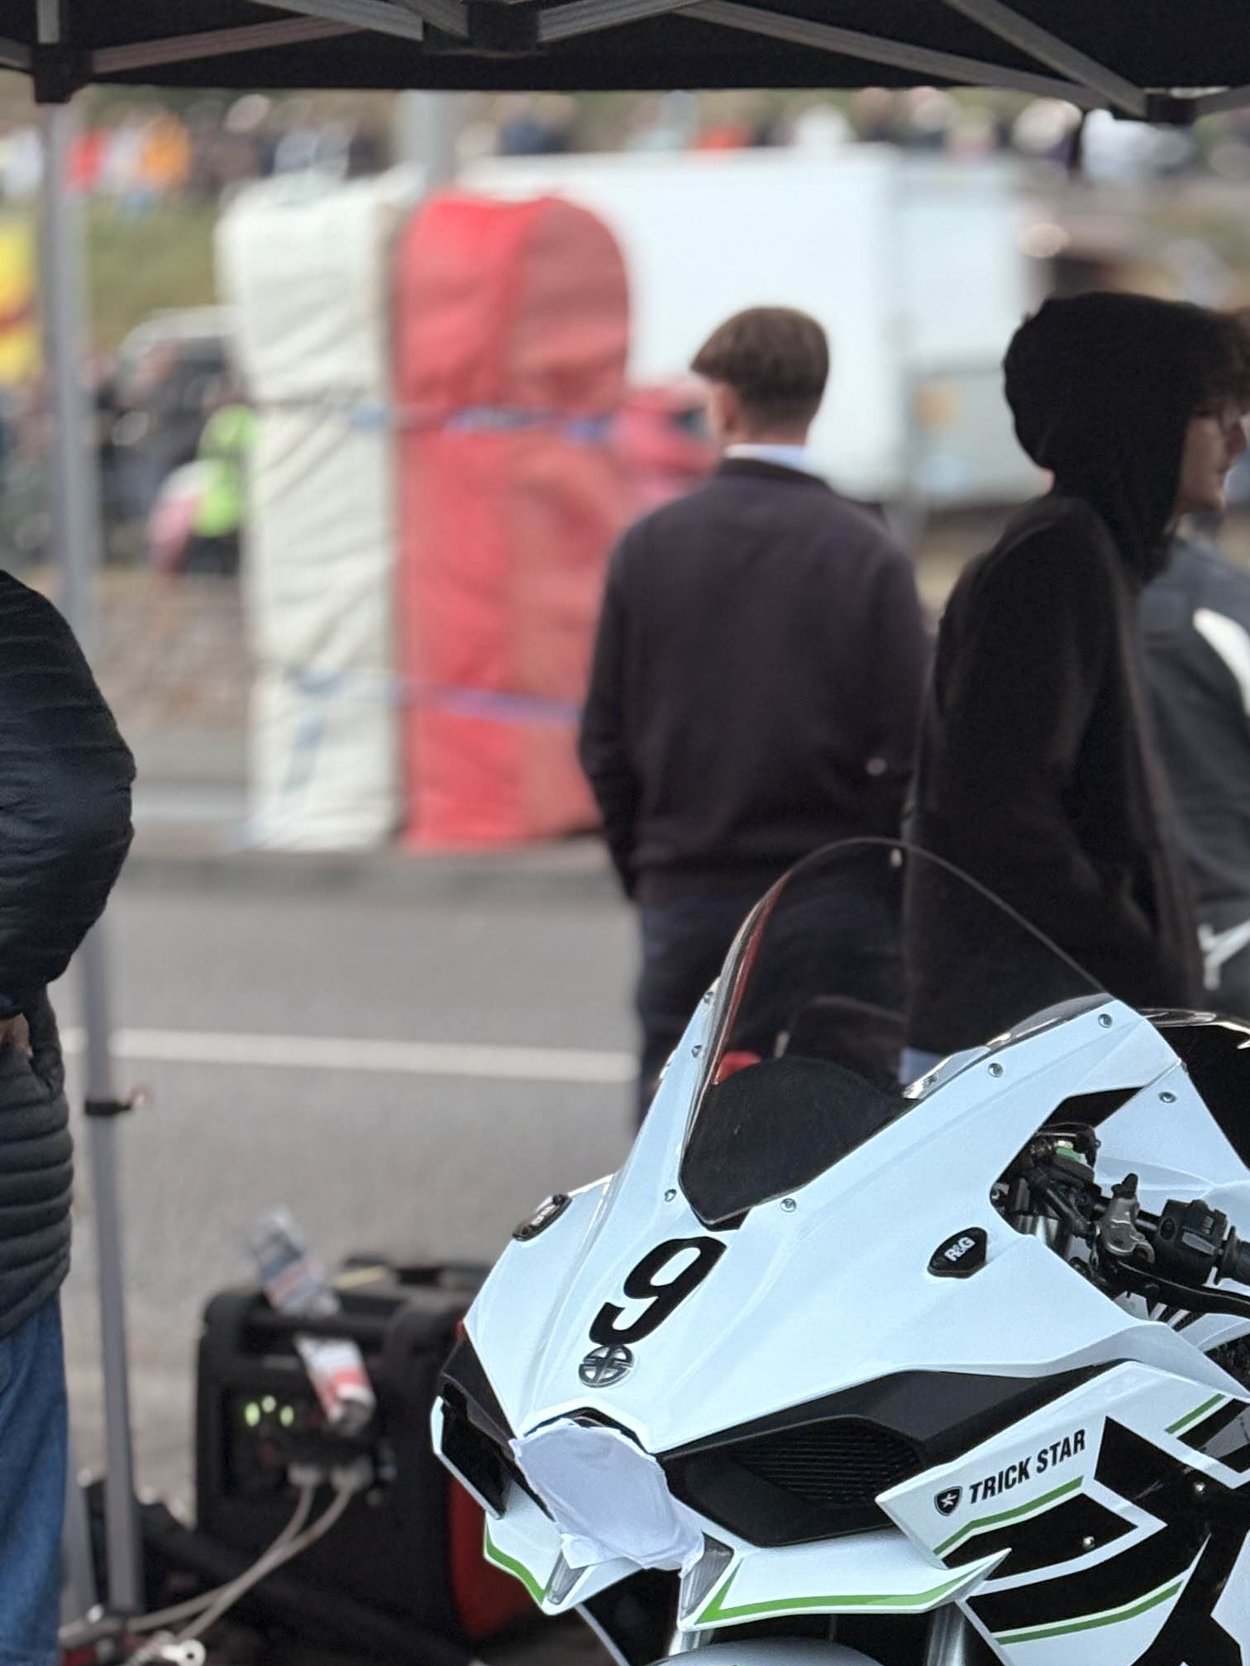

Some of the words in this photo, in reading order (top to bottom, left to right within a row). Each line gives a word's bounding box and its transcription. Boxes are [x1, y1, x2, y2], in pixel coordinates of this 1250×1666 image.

[944, 1236, 976, 1262] R&G
[589, 1236, 728, 1345] 9
[969, 1456, 1032, 1504] TRICK
[1035, 1429, 1086, 1474] STAR
